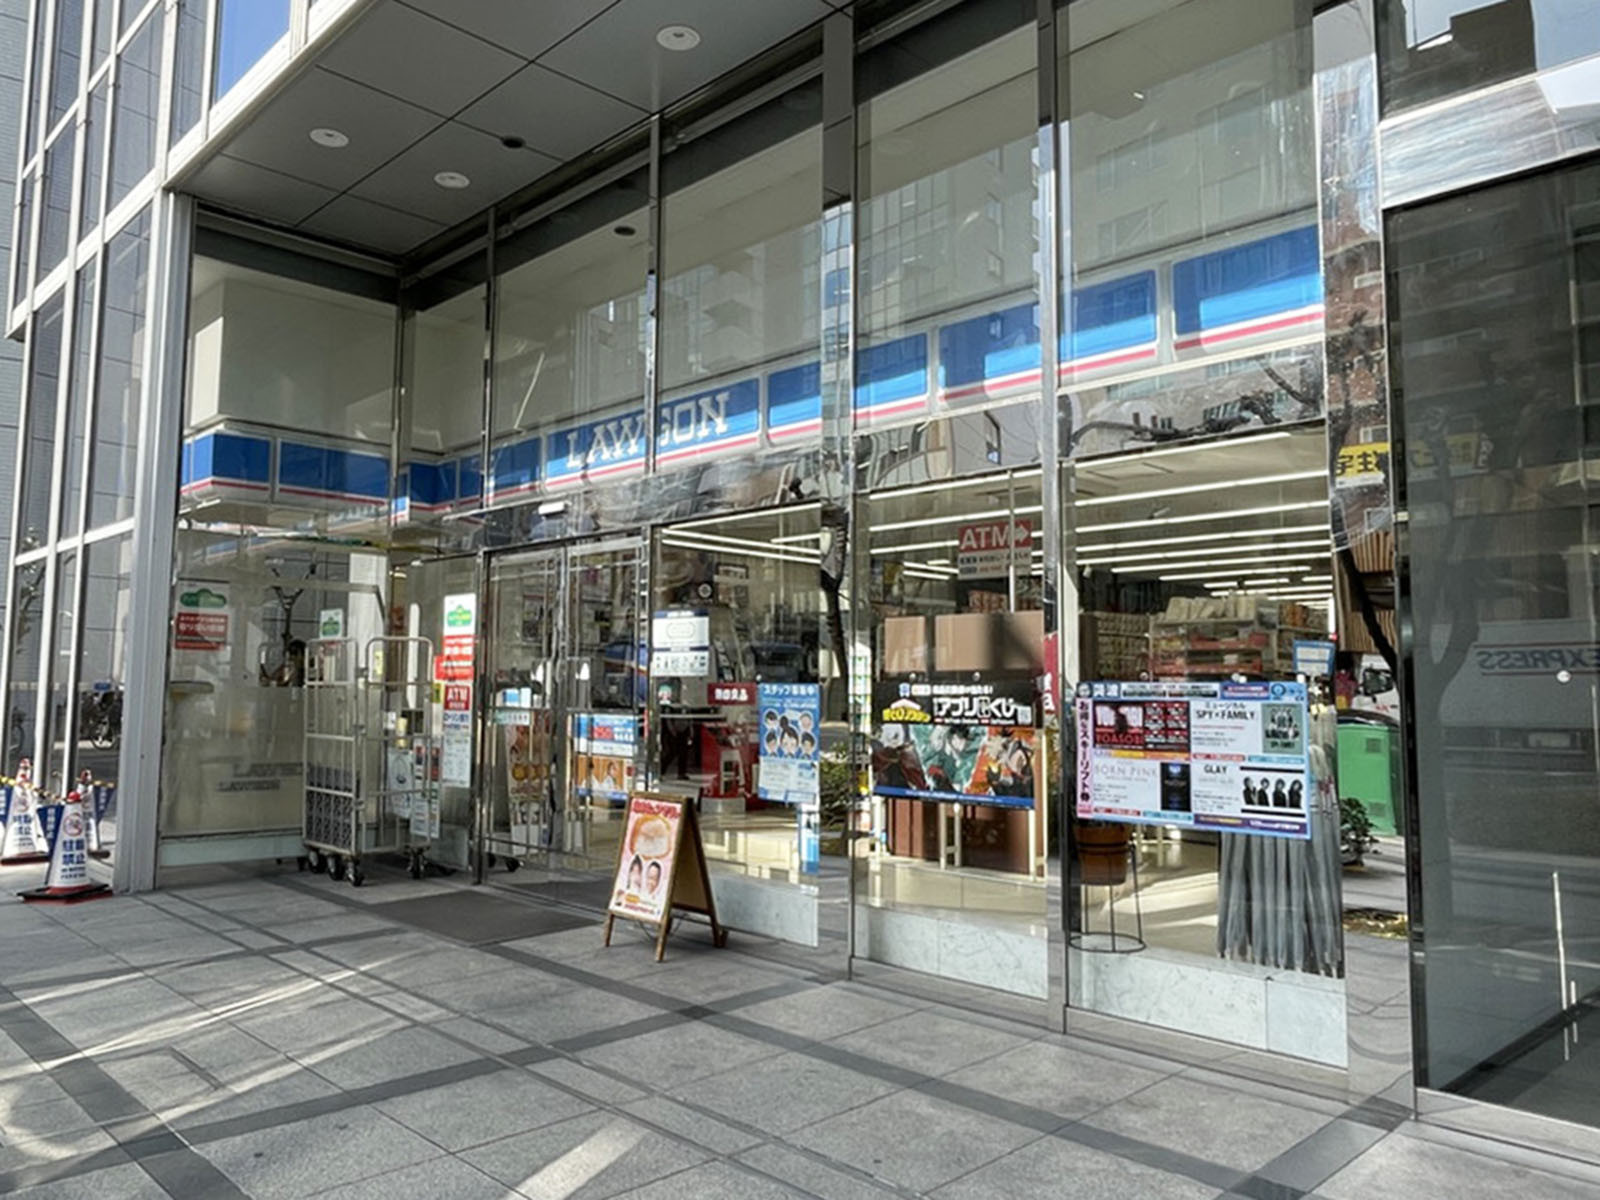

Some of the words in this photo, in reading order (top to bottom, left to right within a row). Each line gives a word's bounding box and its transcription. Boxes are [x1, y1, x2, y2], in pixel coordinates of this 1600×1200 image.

[566, 391, 730, 469] LAWSON
[960, 524, 1011, 550] ATM
[447, 687, 469, 700] ATM
[1204, 764, 1228, 775] GLAY
